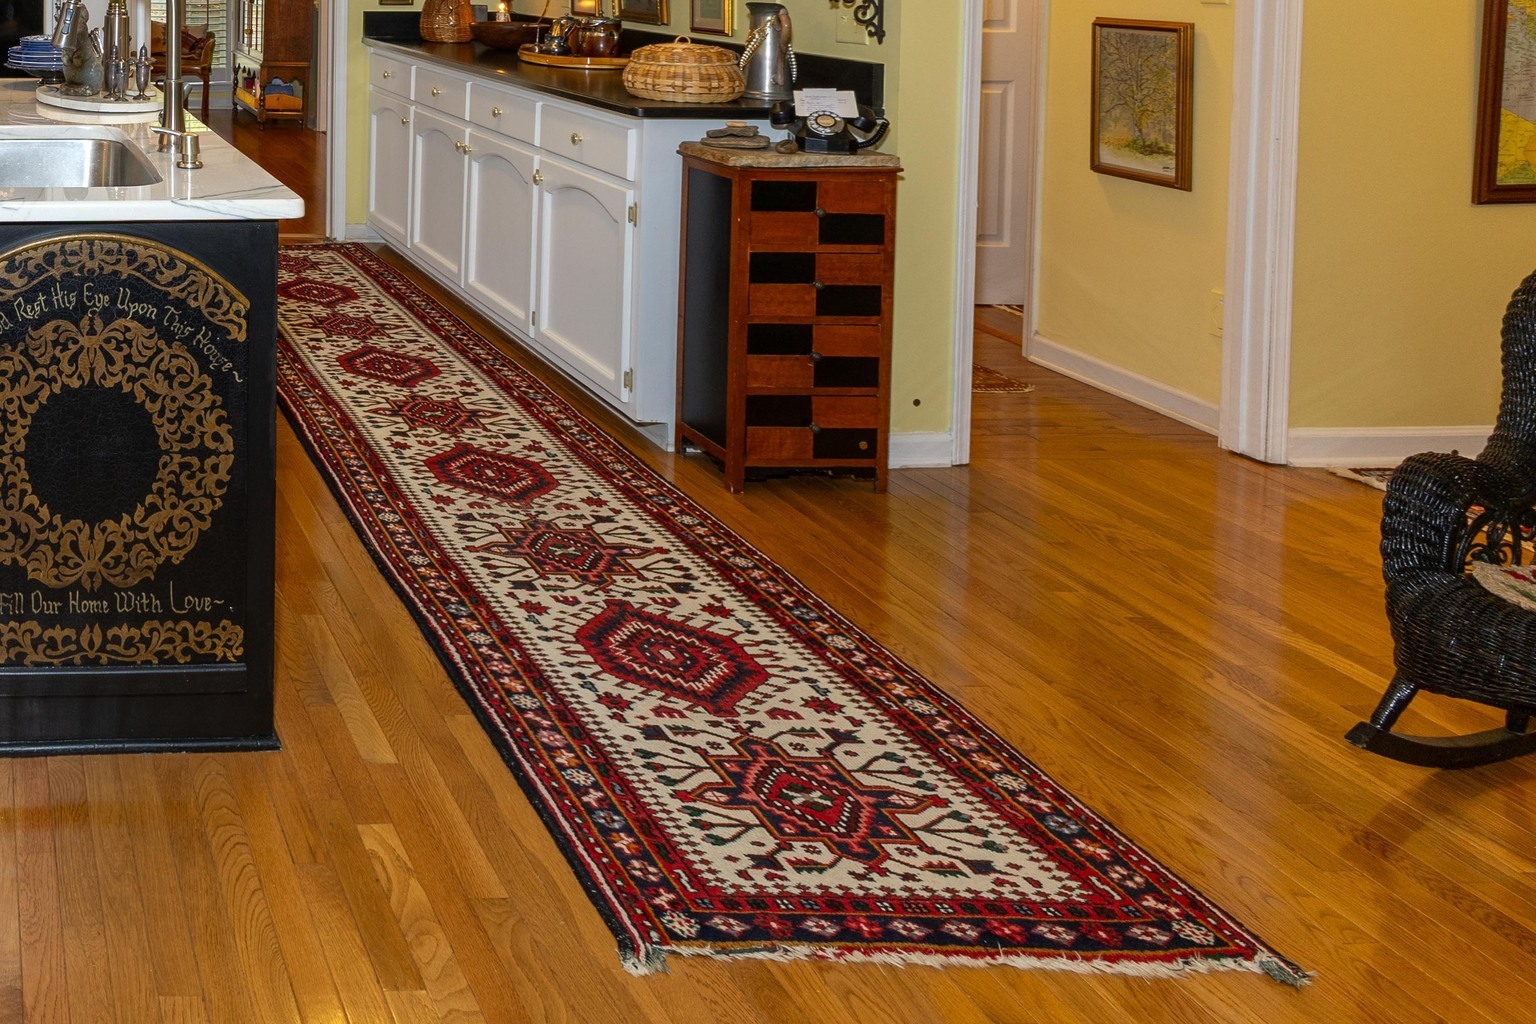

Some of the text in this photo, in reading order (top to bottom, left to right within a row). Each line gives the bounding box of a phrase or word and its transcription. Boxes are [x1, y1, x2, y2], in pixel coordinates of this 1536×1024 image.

[14, 292, 48, 321] Rest
[51, 282, 77, 310] His
[84, 282, 110, 317] Eye
[117, 287, 157, 320] Upon
[164, 305, 194, 339] This
[193, 326, 233, 372] House
[31, 590, 63, 614] Our
[69, 590, 110, 614] Home
[114, 591, 163, 614] With
[169, 580, 212, 614] Love
